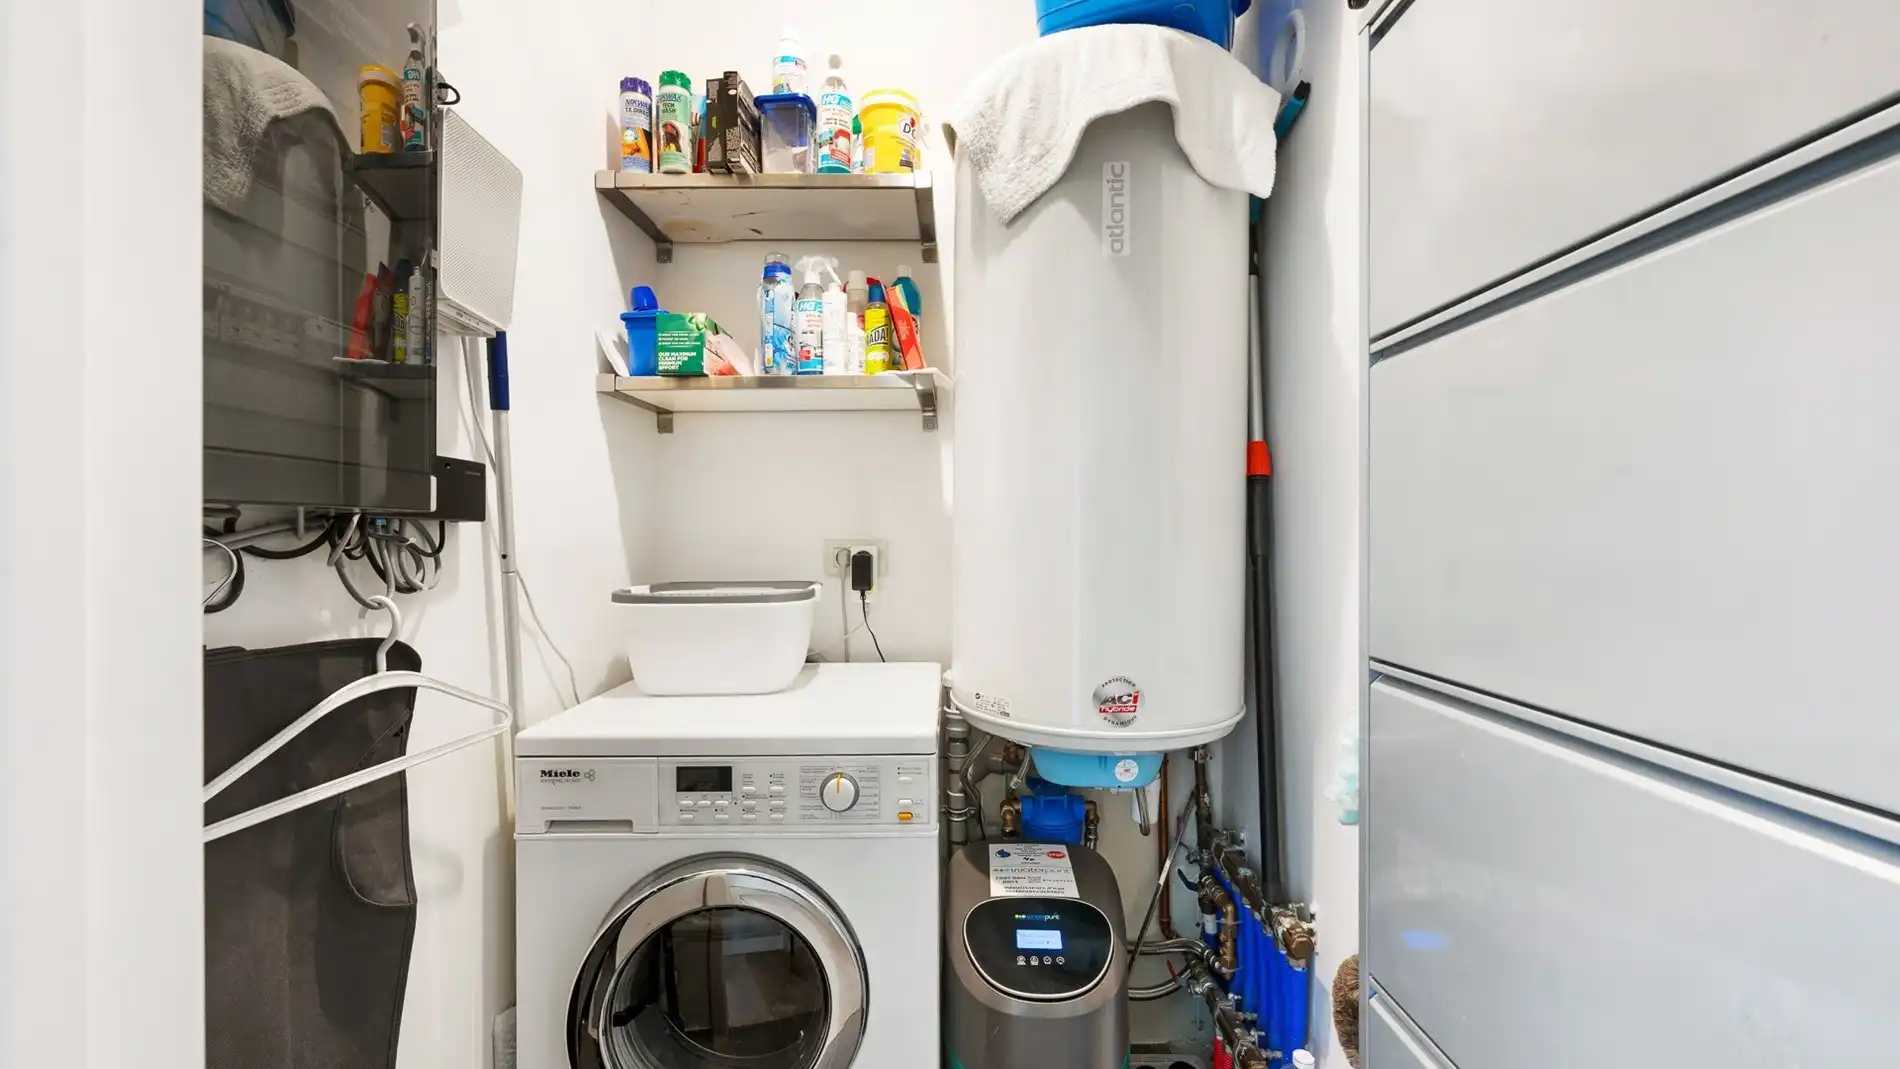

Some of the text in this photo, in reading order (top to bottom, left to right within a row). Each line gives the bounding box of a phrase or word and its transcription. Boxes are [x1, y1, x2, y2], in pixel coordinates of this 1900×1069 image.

[625, 107, 650, 118] TX.DIREC
[1106, 163, 1124, 254] atlantic
[800, 301, 815, 311] HG
[1101, 677, 1136, 688] PROTECTION
[1099, 705, 1137, 713] hybride
[1103, 715, 1137, 726] DYNAMIQUE
[540, 769, 581, 778] Miele
